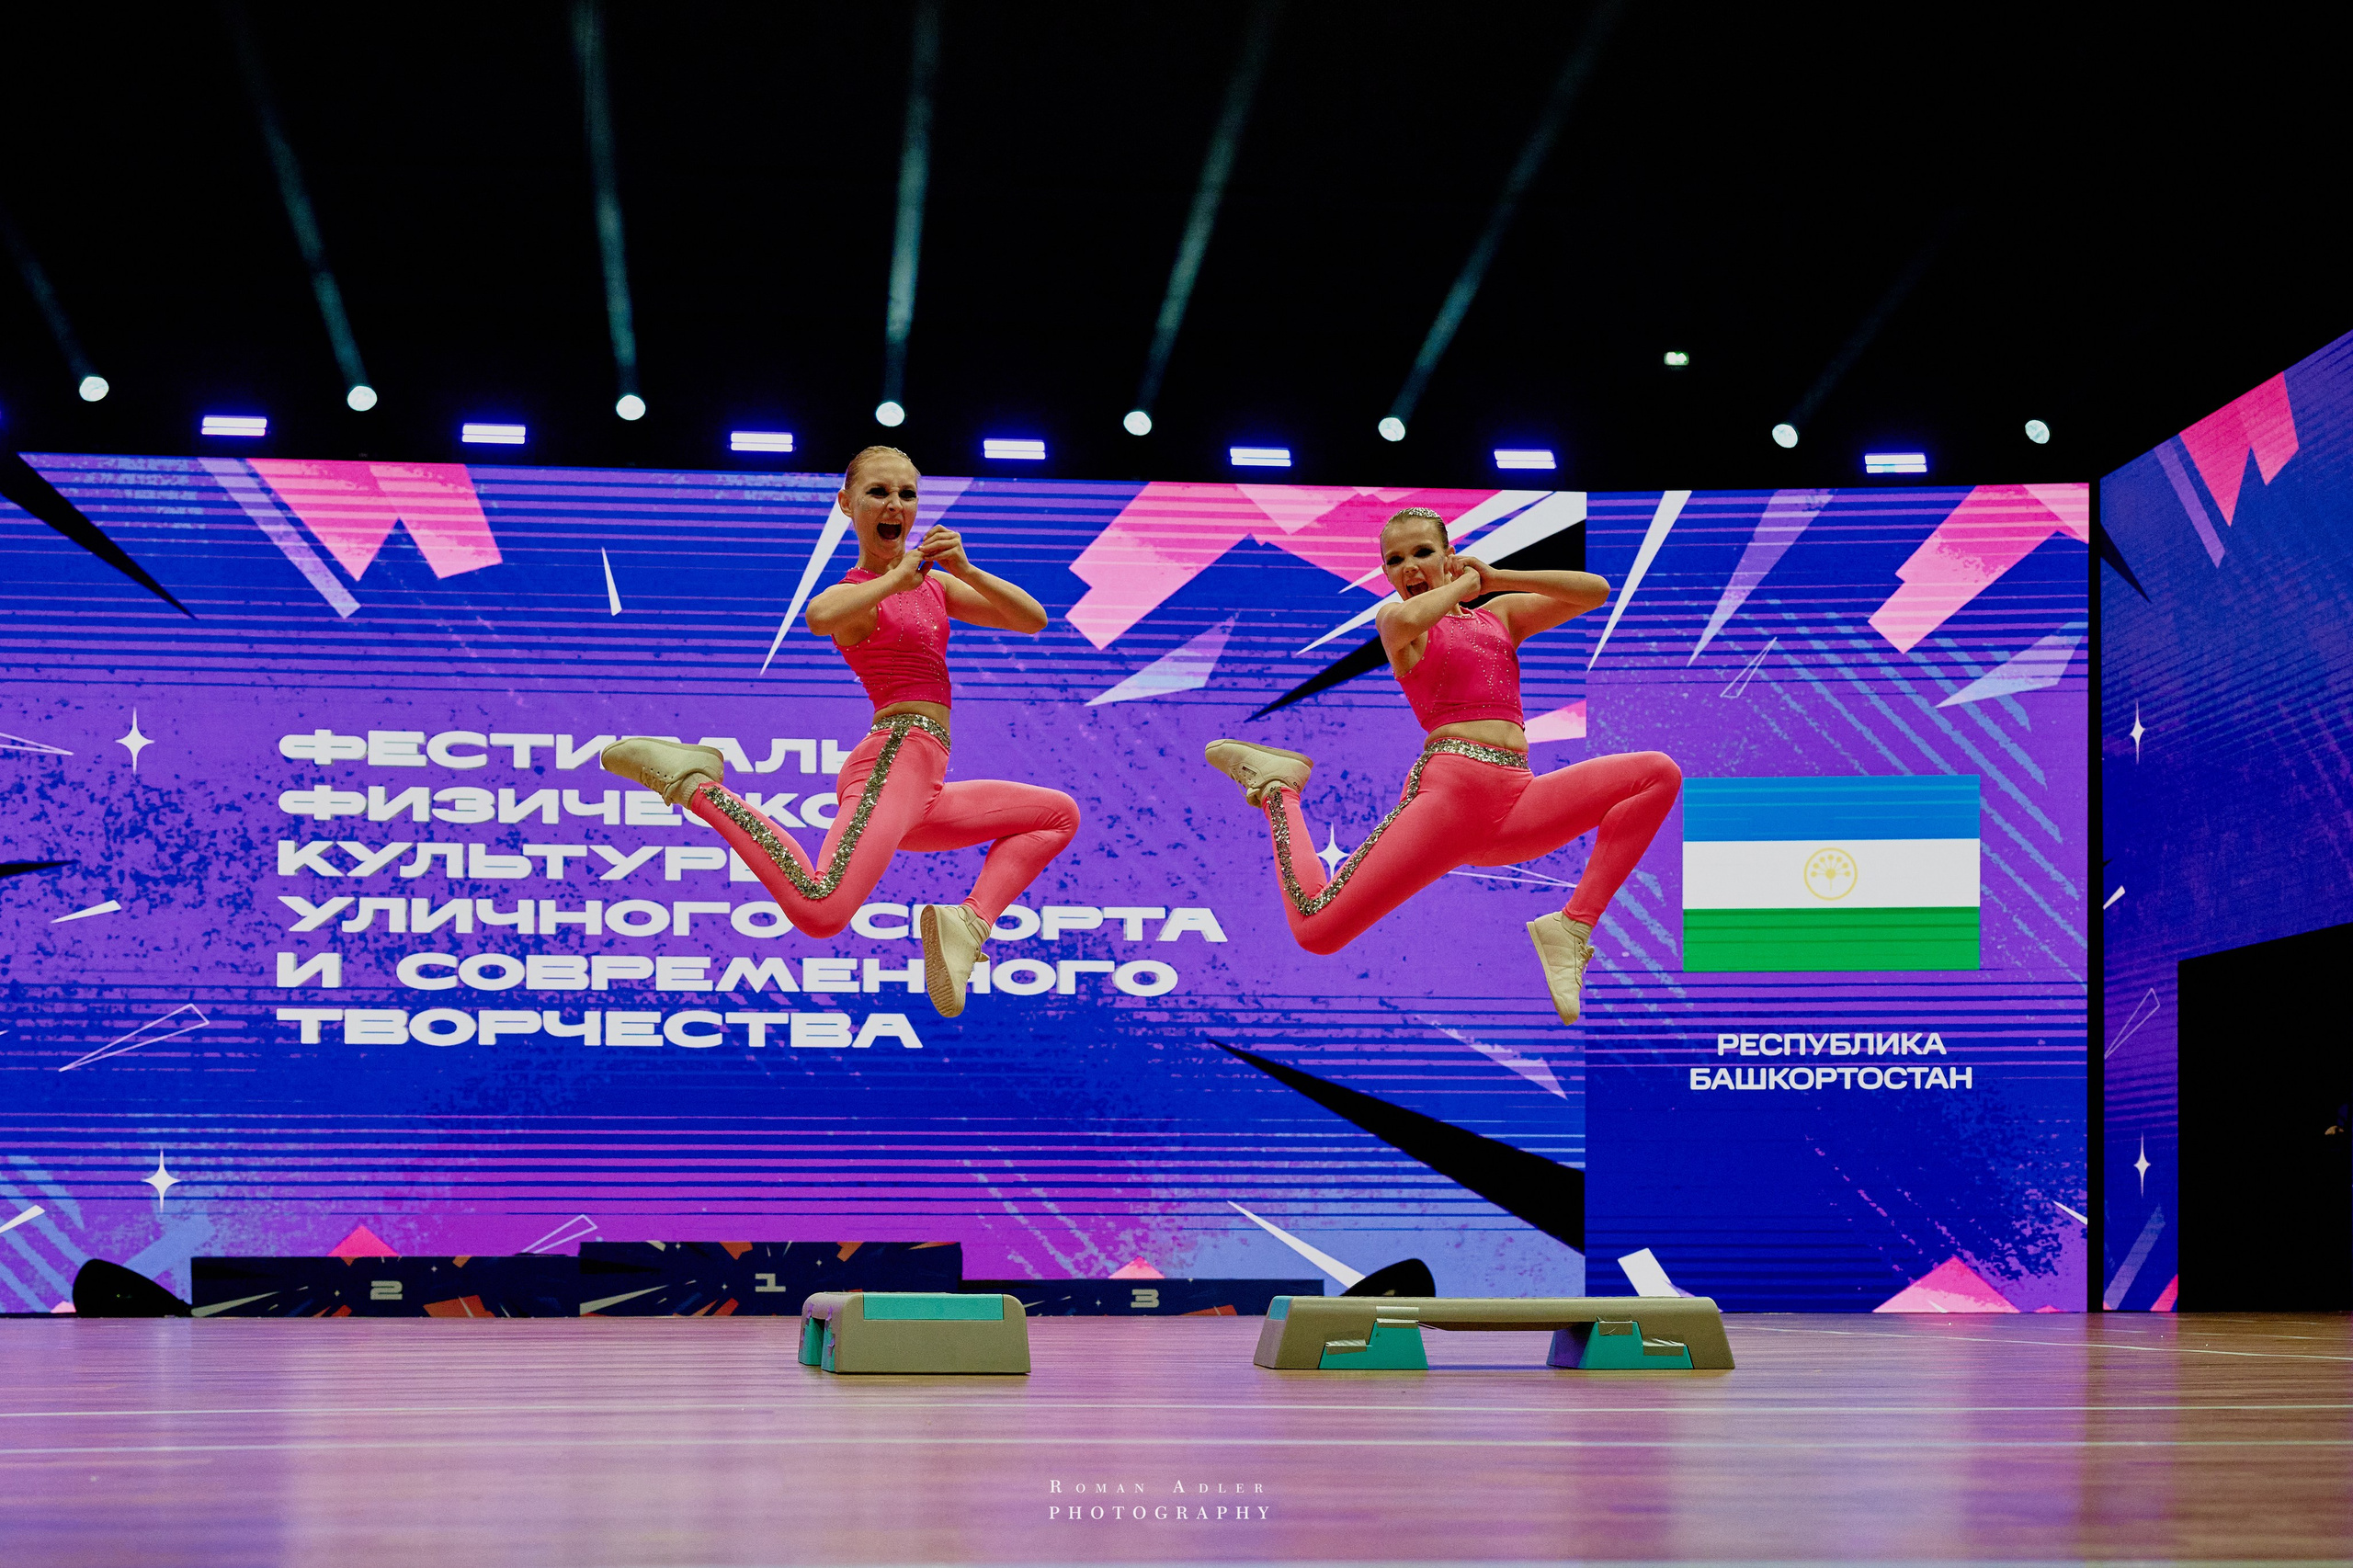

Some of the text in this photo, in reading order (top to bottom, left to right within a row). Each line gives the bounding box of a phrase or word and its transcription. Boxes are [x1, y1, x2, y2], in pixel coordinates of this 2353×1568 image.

[278, 729, 852, 774] ФЕСТИАЛ
[278, 785, 840, 829] ФИЗИЧЕКО
[278, 896, 795, 938] УЛИЧНОГО
[277, 952, 341, 988] И
[277, 1008, 923, 1049] ТВОРЧЕСТВА
[1717, 1032, 1947, 1056] РЕСПУБЛИКА
[1689, 1067, 1972, 1090] БАШКОРТОСТАН
[370, 1280, 403, 1300] 2
[755, 1273, 786, 1292] 1
[1131, 1289, 1159, 1308] 3
